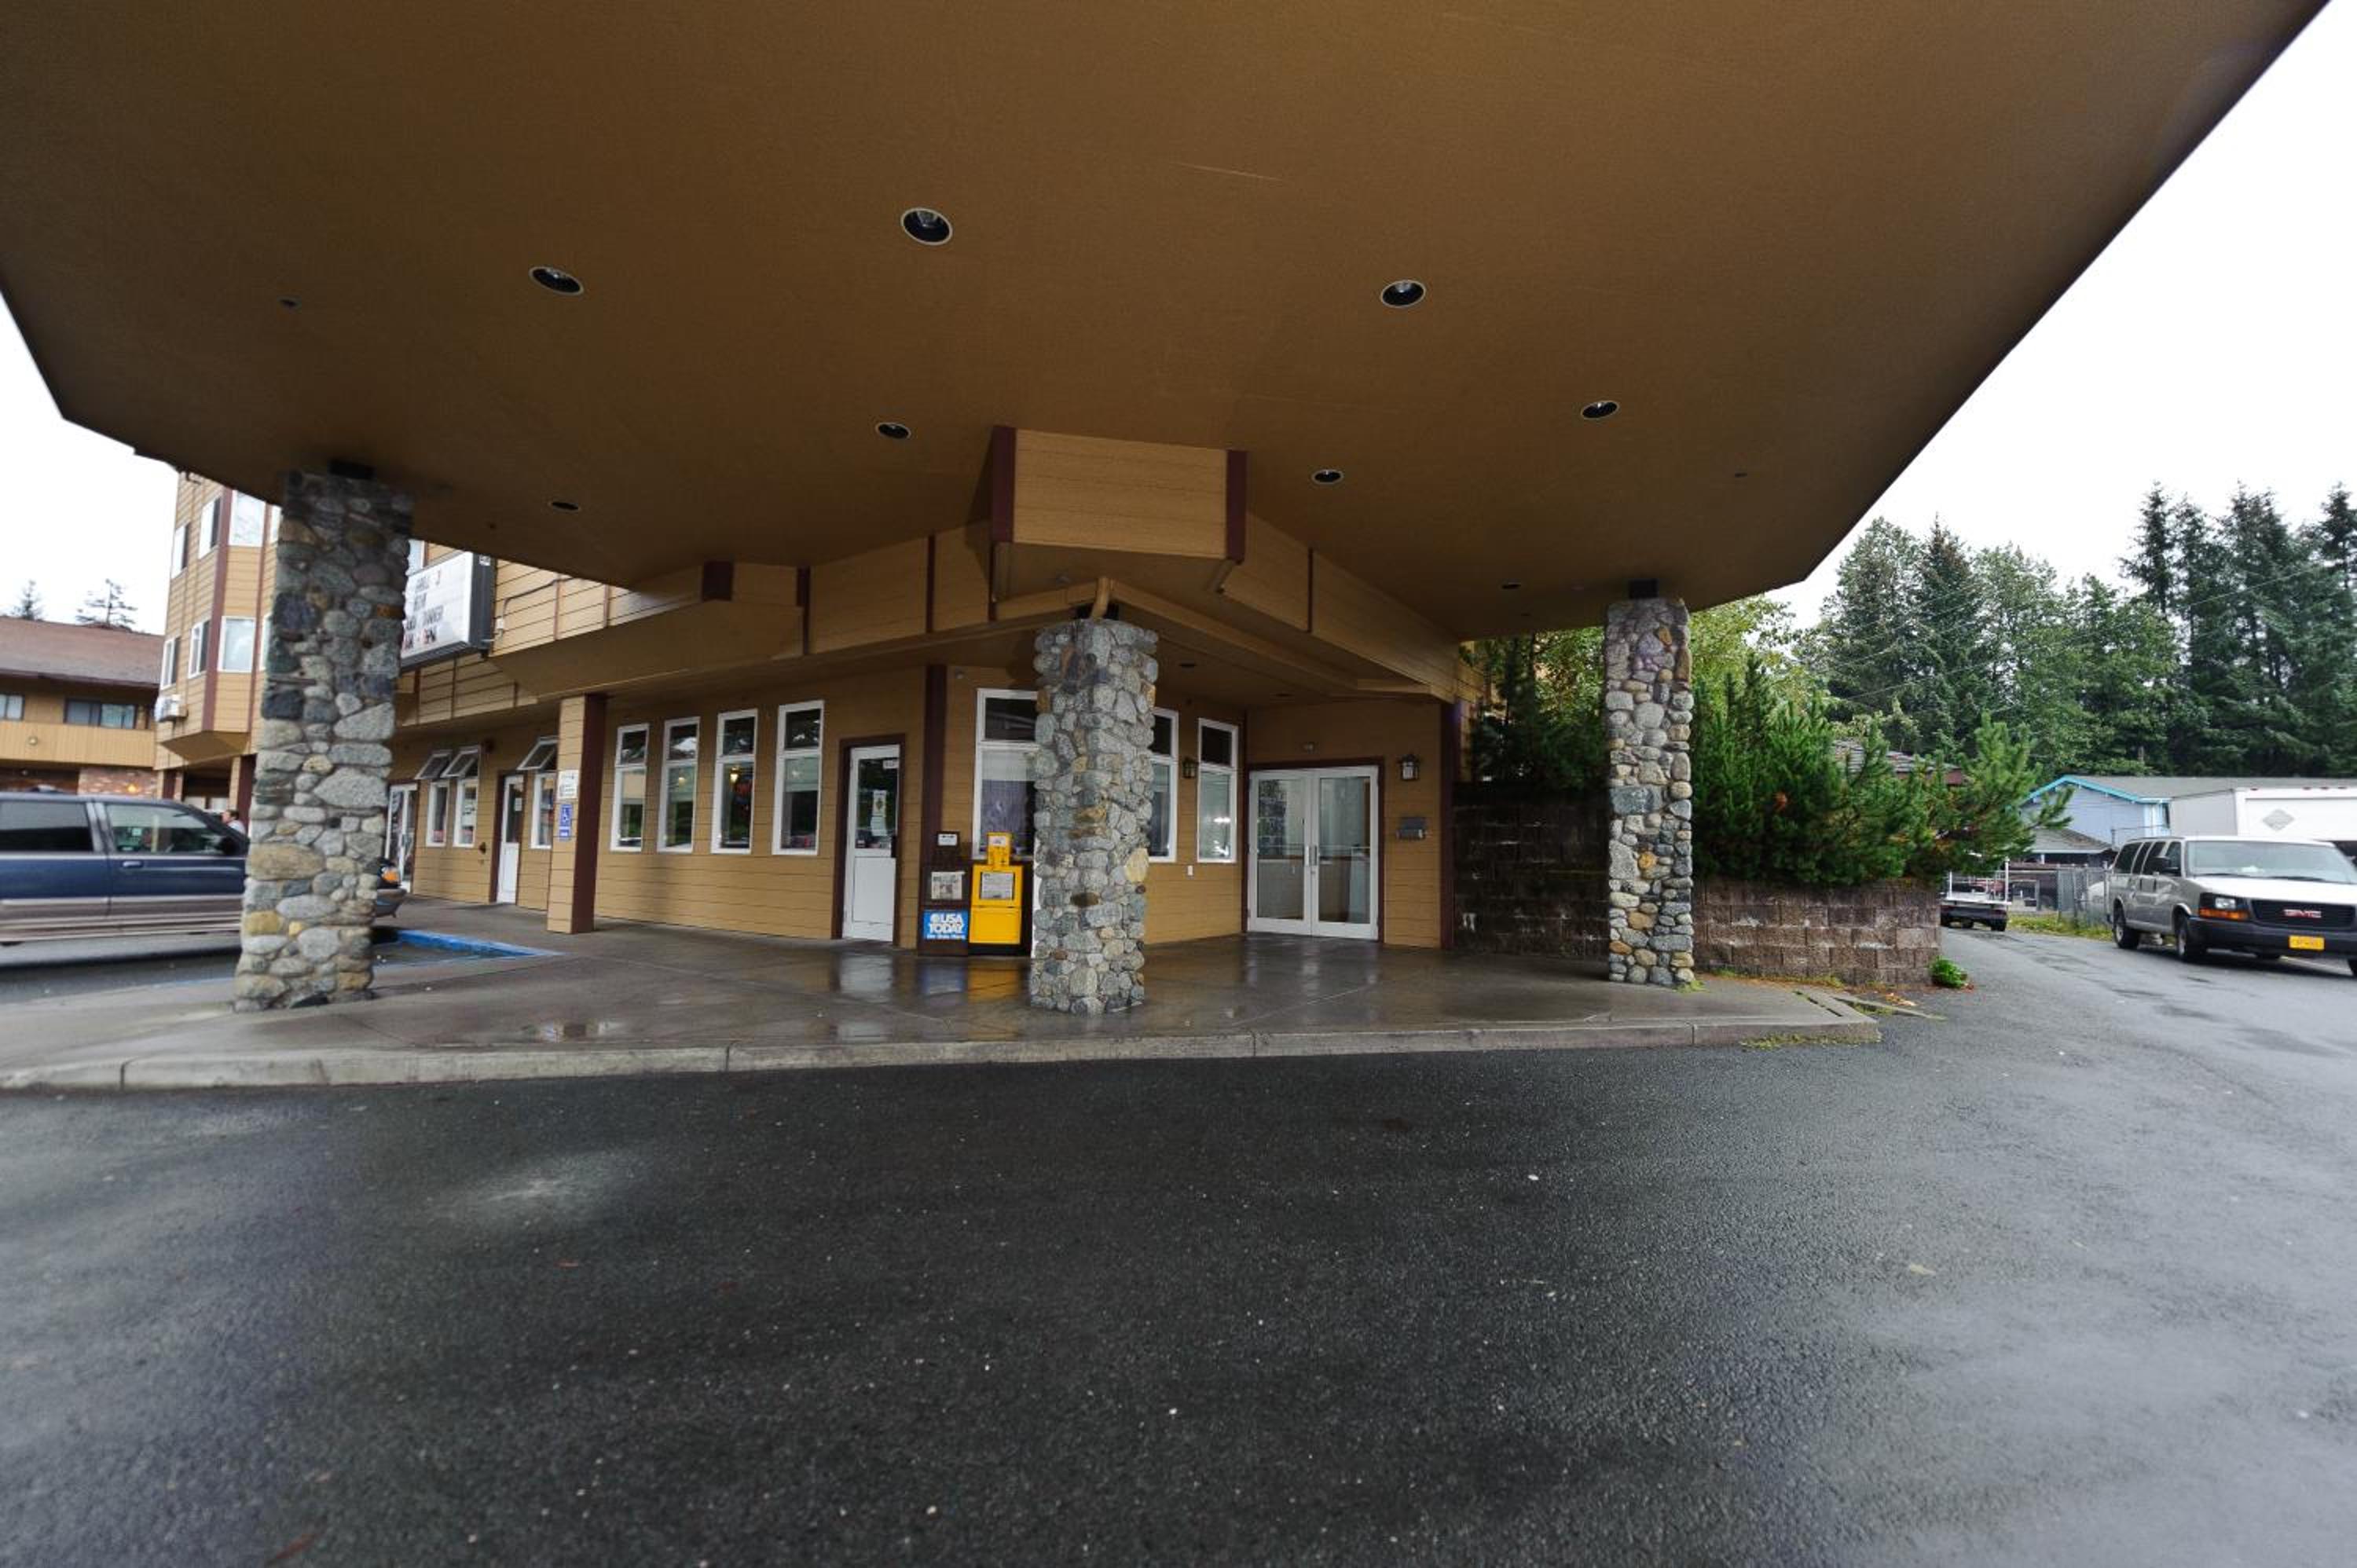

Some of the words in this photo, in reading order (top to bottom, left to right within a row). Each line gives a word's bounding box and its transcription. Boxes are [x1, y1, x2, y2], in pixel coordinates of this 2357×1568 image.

[940, 913, 962, 923] USA
[2284, 909, 2322, 918] GMC
[929, 922, 964, 933] TODAY
